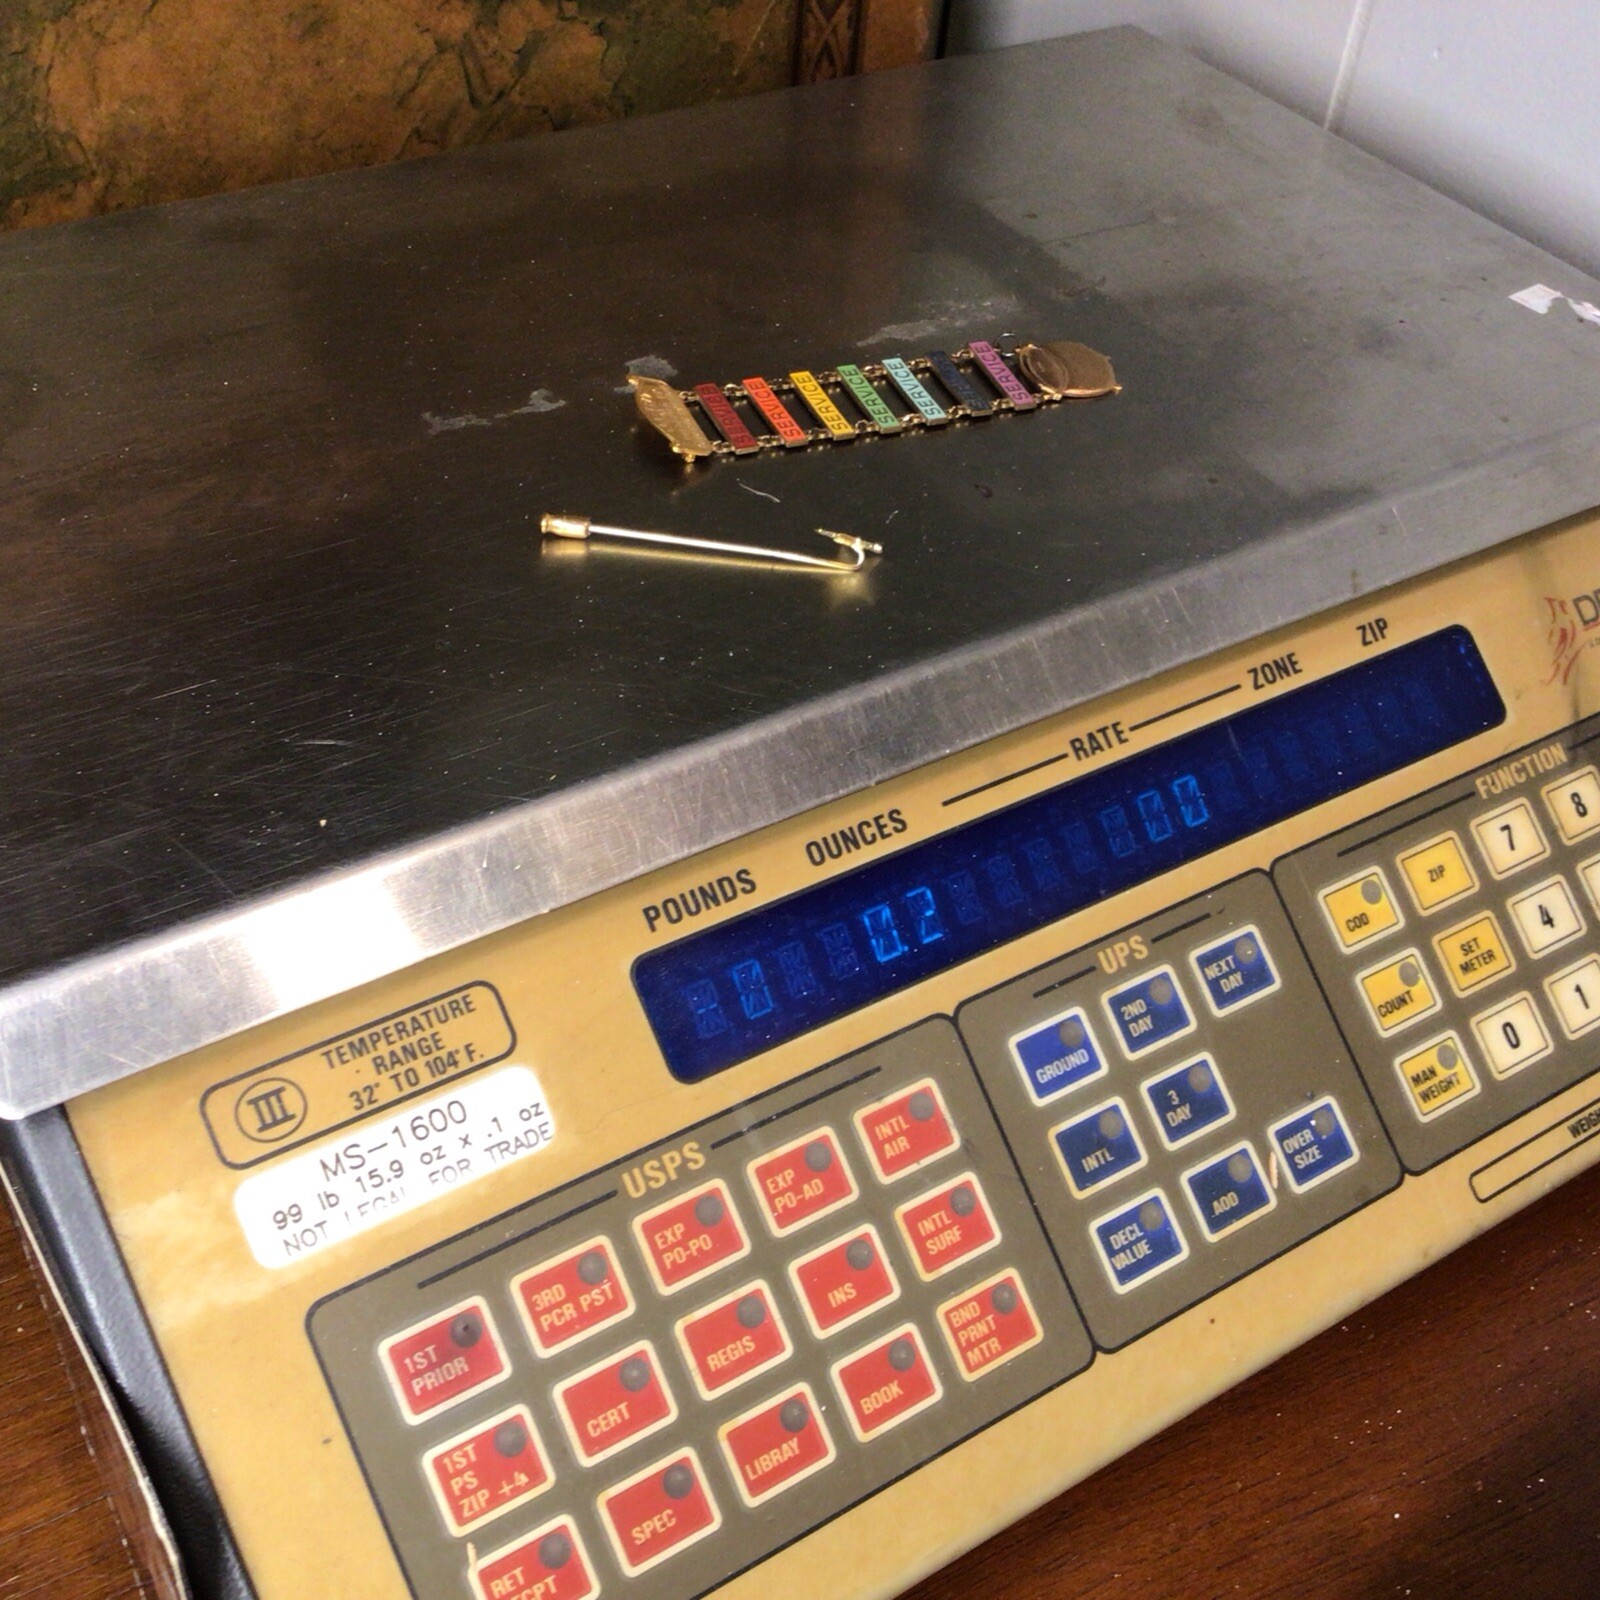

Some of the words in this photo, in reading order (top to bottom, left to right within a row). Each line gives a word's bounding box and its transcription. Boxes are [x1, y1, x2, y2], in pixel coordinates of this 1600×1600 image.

[976, 345, 1029, 400] SERVICE
[796, 374, 849, 431] SERVICE
[844, 367, 894, 424] SERVICE
[888, 360, 940, 416] SERVICE
[749, 381, 800, 437] SERVICE
[1356, 617, 1389, 648] ZIP
[1246, 652, 1303, 691] ZONE
[1069, 721, 1129, 762] RATE
[1474, 742, 1567, 799] FUNCTION
[1570, 791, 1588, 818] 8
[1500, 824, 1516, 852] 7
[642, 868, 757, 933] POUNDS
[805, 808, 909, 867] OUNCES
[1427, 864, 1447, 884] ZIP
[1345, 912, 1371, 934] COD
[1540, 904, 1556, 930] 4
[1097, 935, 1149, 975] UPS
[1460, 937, 1481, 957] SET
[1204, 955, 1235, 981] NEXT
[1459, 949, 1496, 976] METER
[1219, 970, 1245, 993] DAY
[1121, 998, 1147, 1020] 2ND
[1377, 990, 1414, 1019] COUNT
[1574, 984, 1590, 1010] 1
[320, 993, 476, 1070] TEMPERATURE
[1128, 1015, 1153, 1037] DAY
[1502, 1021, 1520, 1050] 0
[371, 1031, 446, 1075] RANGE
[1035, 1048, 1090, 1084] GROUND
[389, 1068, 420, 1093] TO
[1411, 1065, 1438, 1089] MAN
[1418, 1073, 1462, 1104] WEIGHT
[1167, 1090, 1180, 1105] 3
[874, 1114, 910, 1140] INTL
[1166, 1103, 1192, 1127] DAY
[320, 1100, 467, 1182] MS-1600
[883, 1134, 911, 1159] AIR
[1283, 1129, 1314, 1154] OVER
[272, 1203, 303, 1230] 99
[317, 1190, 340, 1211] lb
[355, 1159, 404, 1194] 15.9
[420, 1145, 447, 1166] oz
[458, 1134, 472, 1149] x
[518, 1102, 544, 1122] oz
[621, 1140, 706, 1199] USPS
[1081, 1146, 1114, 1174] INTL
[1294, 1144, 1323, 1169] SIZE
[283, 1219, 329, 1256] NOT
[428, 1158, 473, 1185] FOR
[484, 1121, 553, 1164] TRADE
[765, 1168, 796, 1194] EXP
[774, 1178, 824, 1214] PO-AD
[654, 1223, 686, 1251] EXP
[917, 1211, 953, 1237] INTL
[1109, 1223, 1144, 1249] DECL
[662, 1233, 713, 1270] PO-PO
[925, 1225, 963, 1256] SURF
[1111, 1239, 1152, 1271] VALUE
[532, 1283, 566, 1312] 3RD
[539, 1301, 578, 1333] PCR
[579, 1281, 615, 1313] PST
[827, 1282, 857, 1308] INS
[949, 1301, 981, 1328] BND
[958, 1313, 996, 1348] PRNT
[403, 1345, 437, 1373] 1ST
[706, 1336, 756, 1373] REGIS
[966, 1337, 1002, 1367] MTR
[411, 1356, 469, 1396] PRIOR
[860, 1381, 904, 1416] BOOK
[586, 1402, 632, 1438] CERT
[442, 1443, 477, 1474] 1ST
[745, 1438, 801, 1481] LIBRAY
[450, 1470, 479, 1496] PS
[458, 1489, 490, 1518] ZIP
[631, 1509, 677, 1547] SPEC
[490, 1566, 524, 1599] RET
